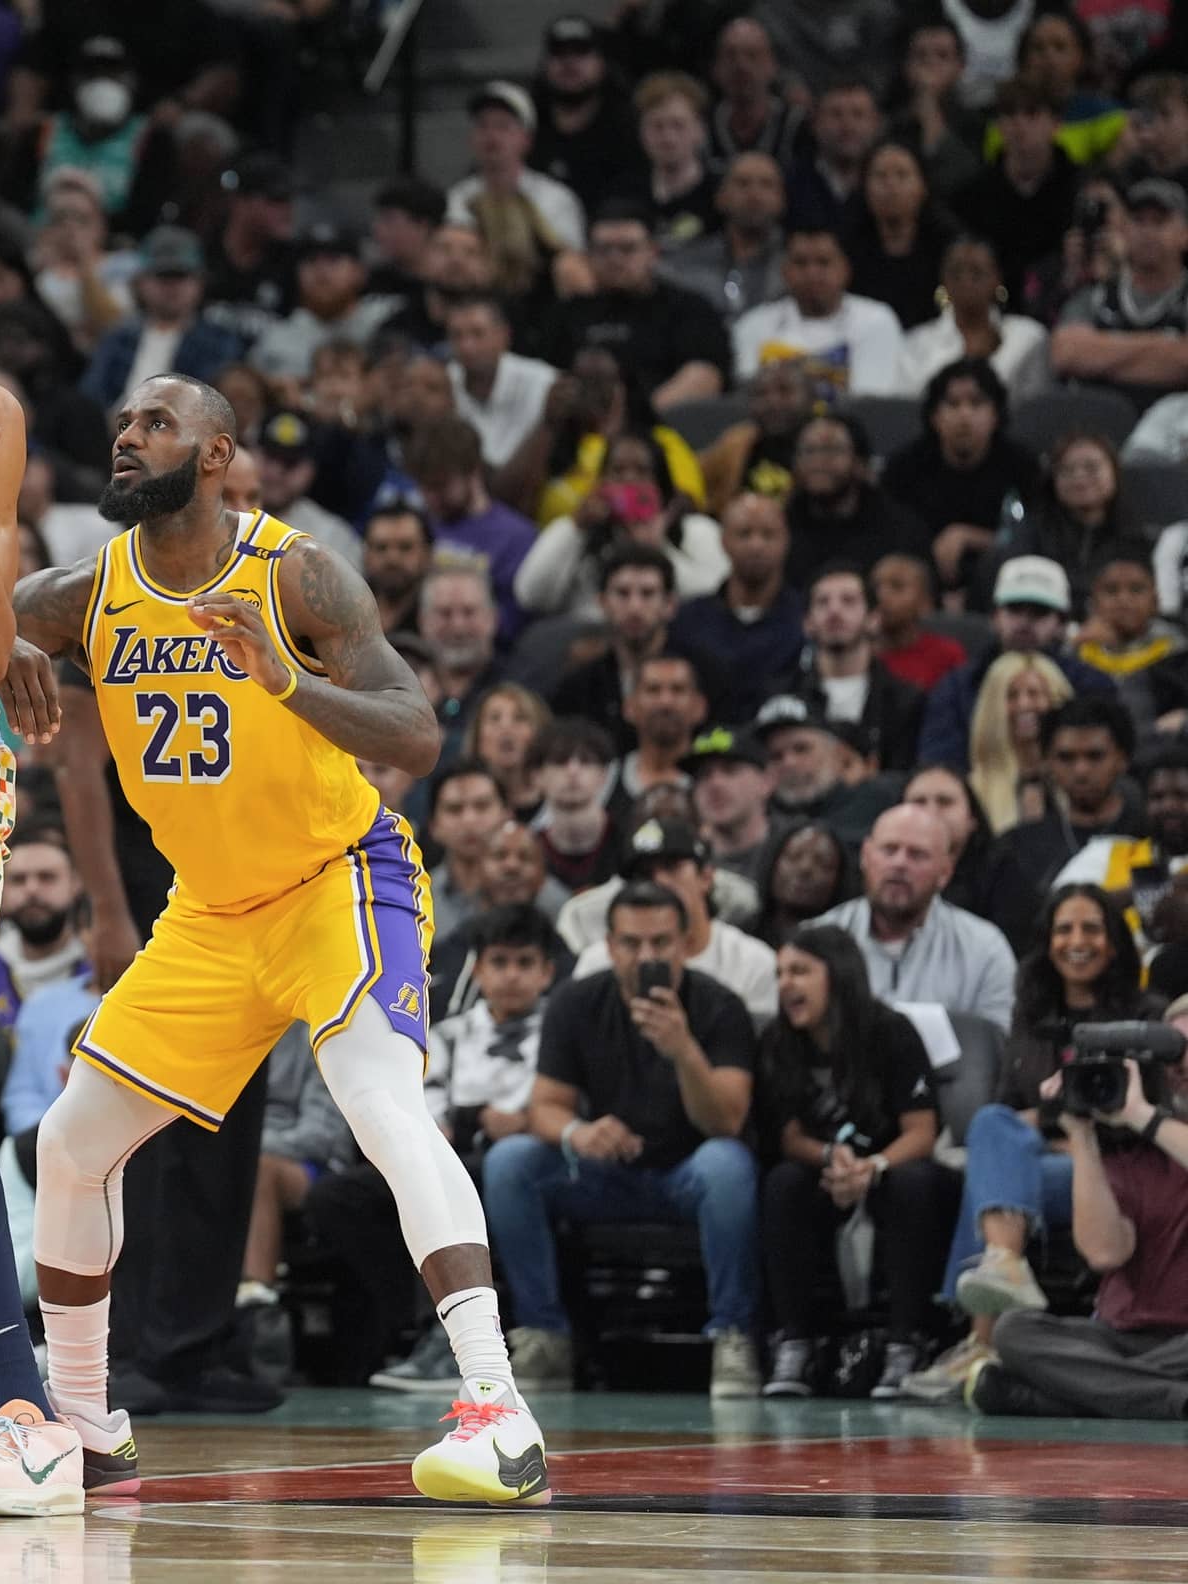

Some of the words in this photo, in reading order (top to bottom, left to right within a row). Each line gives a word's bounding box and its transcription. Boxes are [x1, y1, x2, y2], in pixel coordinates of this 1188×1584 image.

[255, 548, 270, 559] 44
[102, 627, 250, 684] LAKER
[134, 691, 233, 784] 23
